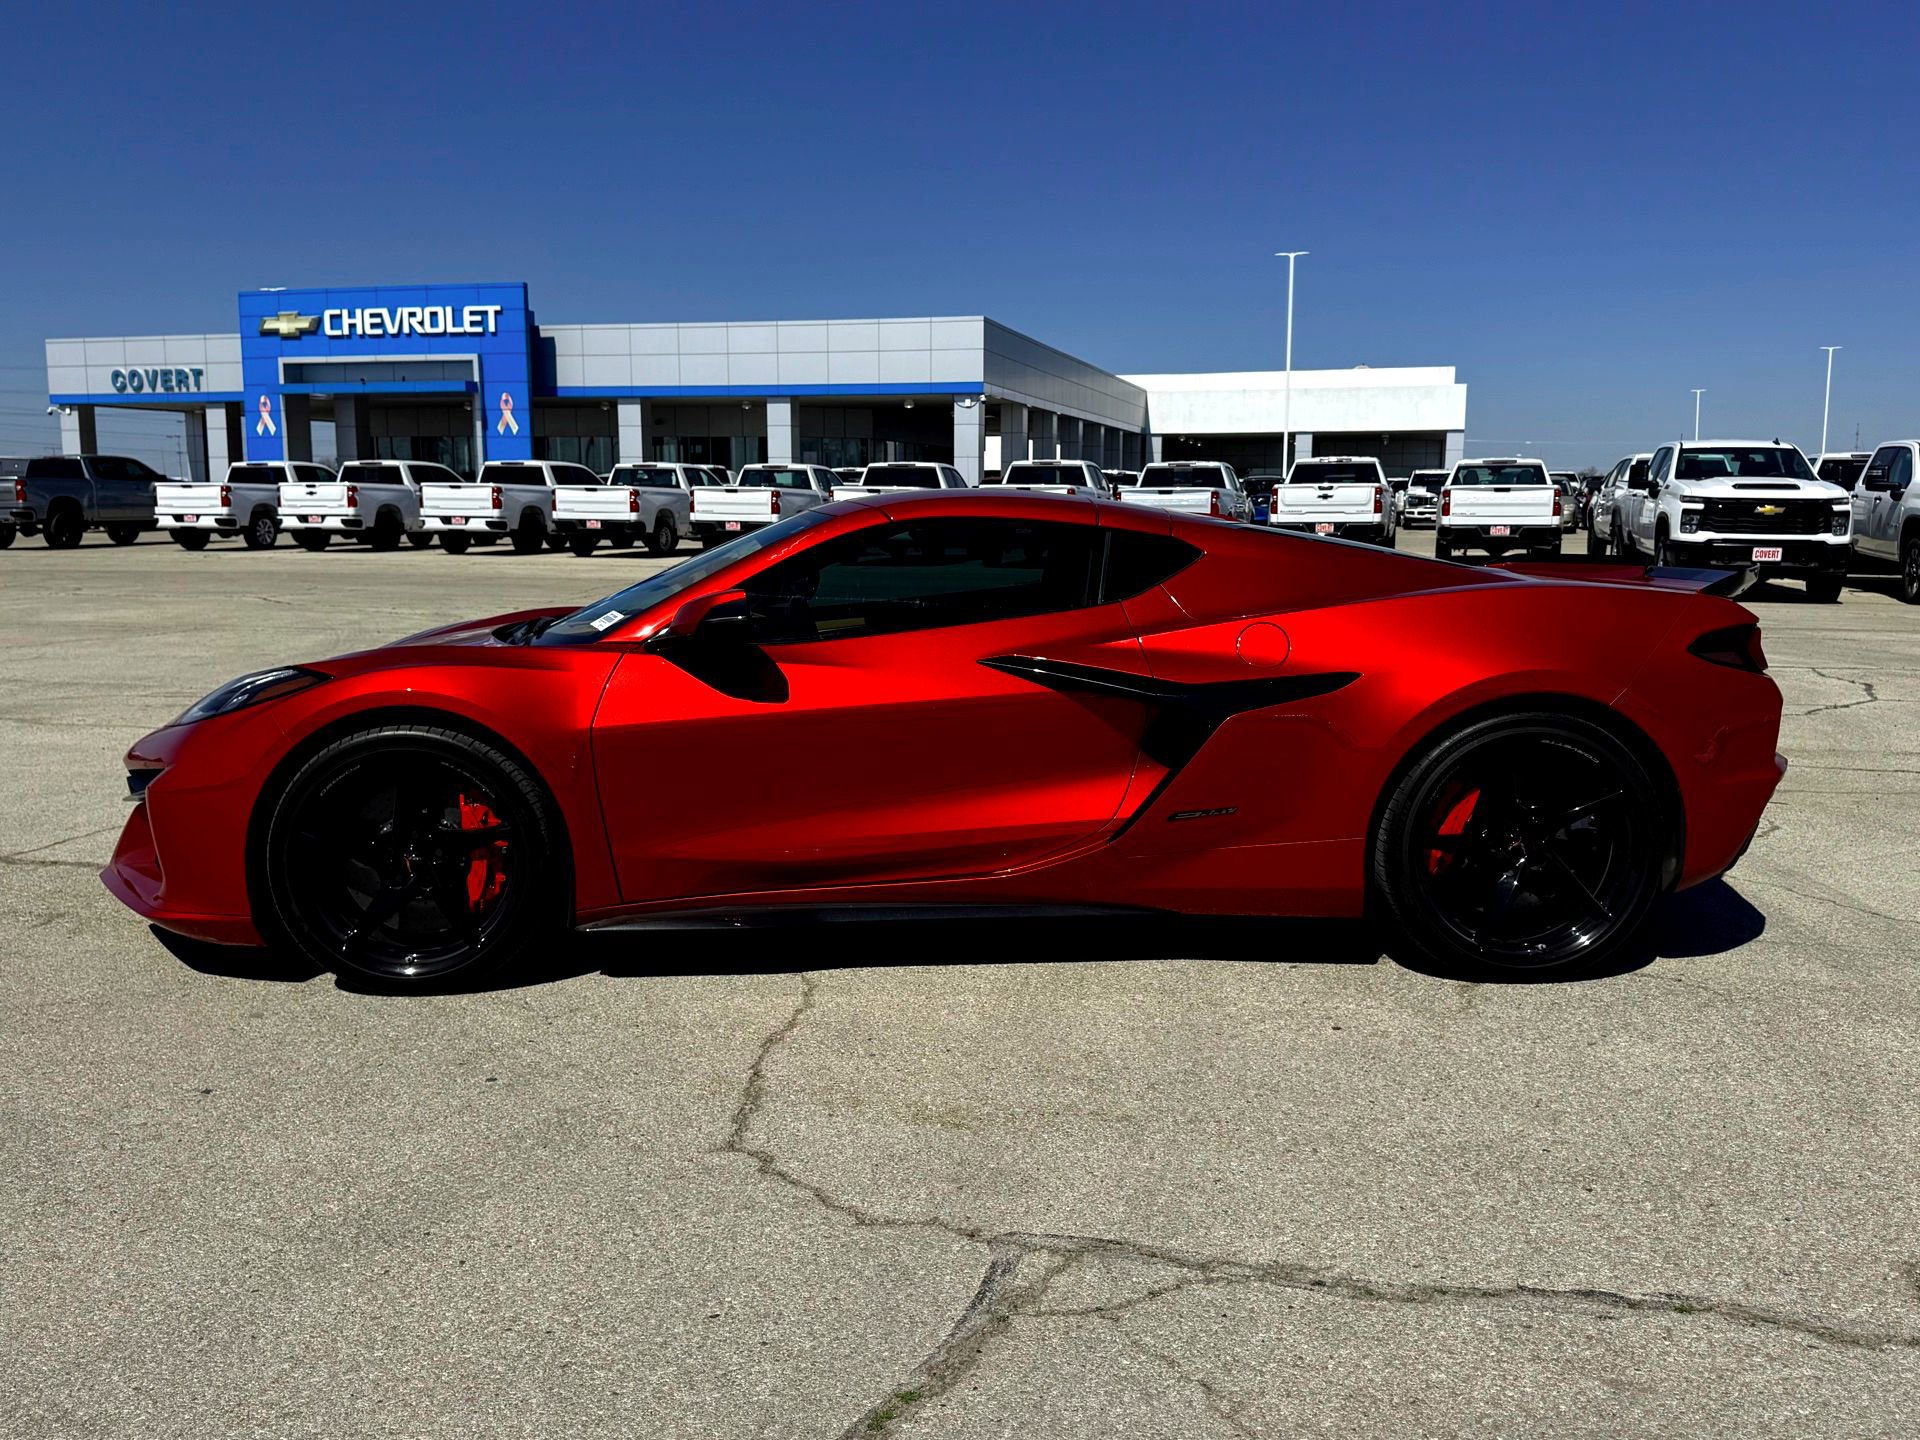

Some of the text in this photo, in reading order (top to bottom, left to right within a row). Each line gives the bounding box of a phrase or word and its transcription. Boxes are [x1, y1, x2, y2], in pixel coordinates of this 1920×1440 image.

[323, 305, 502, 337] CHEVROLET
[111, 368, 204, 394] COVERT
[1755, 550, 1780, 559] COVERT
